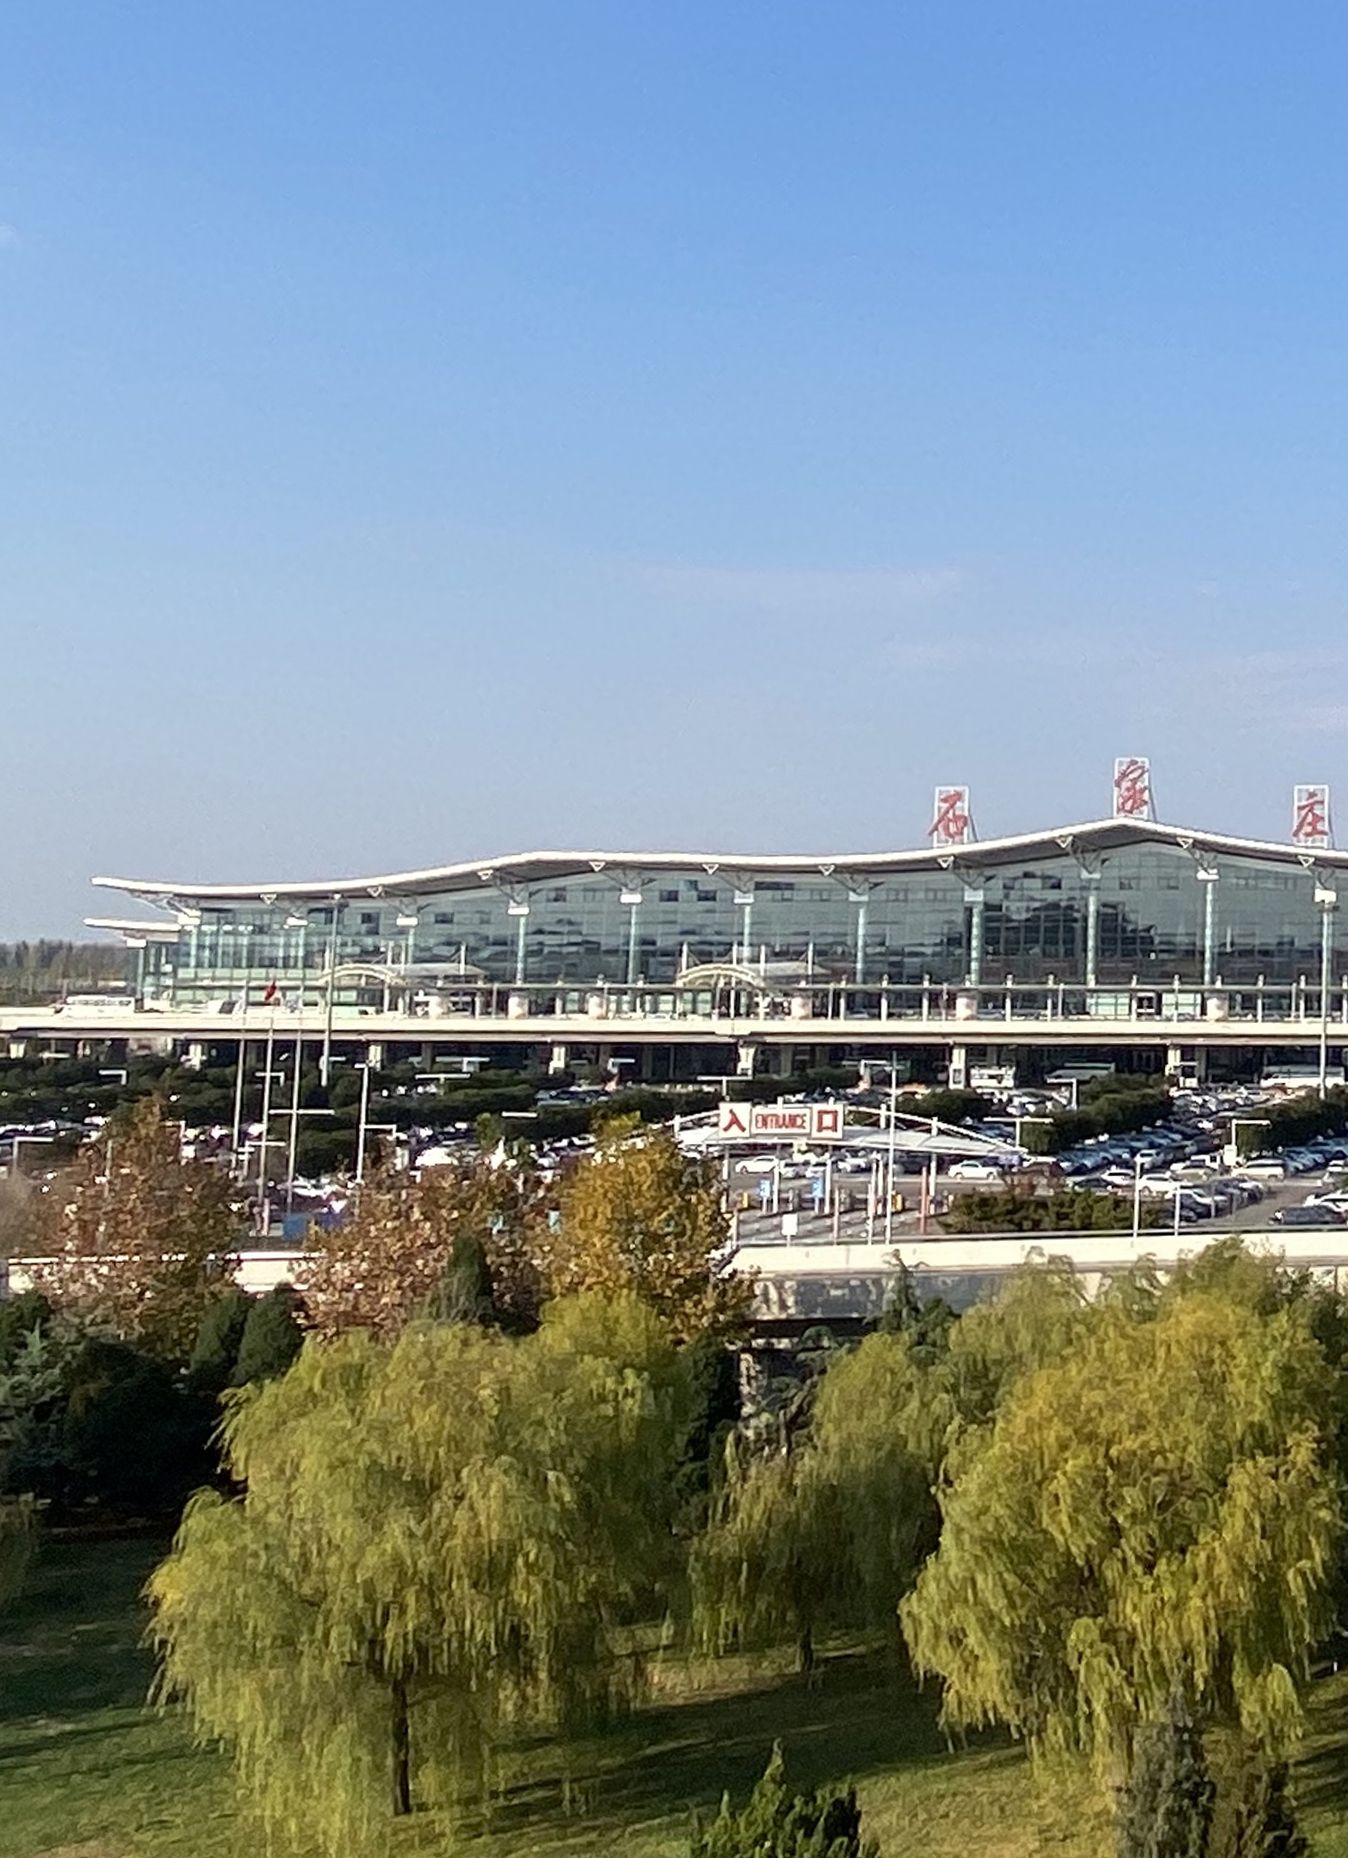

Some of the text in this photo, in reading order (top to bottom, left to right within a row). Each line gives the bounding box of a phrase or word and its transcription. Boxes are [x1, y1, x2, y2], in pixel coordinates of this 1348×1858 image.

[723, 1108, 838, 1132] 入 ENTRANCE 口
